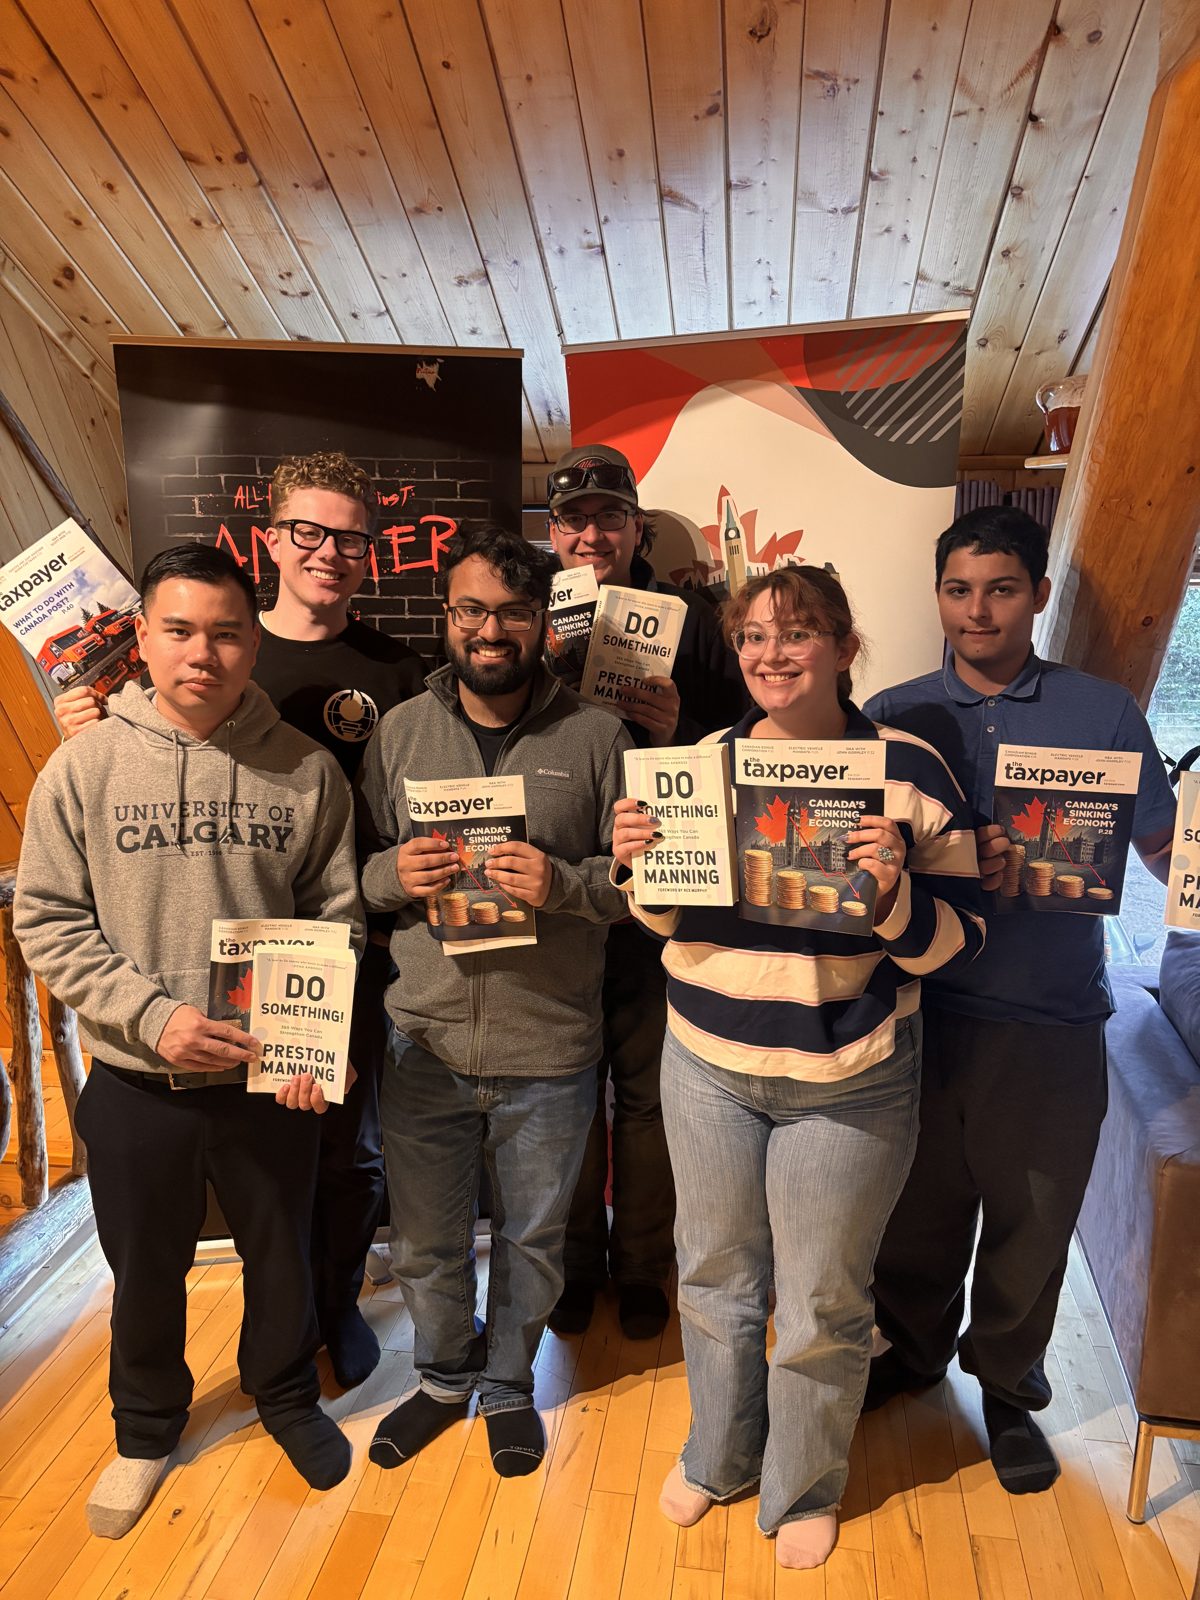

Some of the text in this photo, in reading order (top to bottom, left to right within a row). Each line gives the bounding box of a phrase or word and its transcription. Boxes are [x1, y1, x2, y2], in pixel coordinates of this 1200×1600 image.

[234, 485, 263, 509] ALL
[0, 552, 67, 611] taxpayer
[13, 582, 75, 628] WHAT TO DO WITH
[20, 597, 69, 635] CANADA POST?
[552, 611, 592, 626] CANADA'S
[624, 611, 659, 638] DO
[557, 620, 590, 633] SINKING
[603, 634, 671, 658] SOMETHING!
[543, 769, 570, 778] Columbia
[743, 758, 849, 783] taxpayer
[1005, 763, 1106, 786] taxpayer
[655, 771, 694, 799] DO
[114, 801, 294, 823] UNIVERSITY OF
[408, 797, 494, 817] taxpayer
[808, 799, 866, 809] CANADA'S
[814, 809, 860, 819] SINKING
[1065, 800, 1118, 811] CANADA'S
[808, 818, 862, 829] ECONOM
[1063, 818, 1116, 828] ECONOMY
[1069, 810, 1112, 819] SINKING
[116, 821, 293, 854] CALGARY
[463, 826, 512, 836] CANADA'S
[468, 835, 508, 844] SINKING
[644, 850, 716, 866] PRESTON
[644, 869, 720, 885] MANNING
[285, 973, 325, 1002] DO
[261, 1003, 344, 1023] SOMETHING!
[263, 1043, 336, 1066] PRESTON
